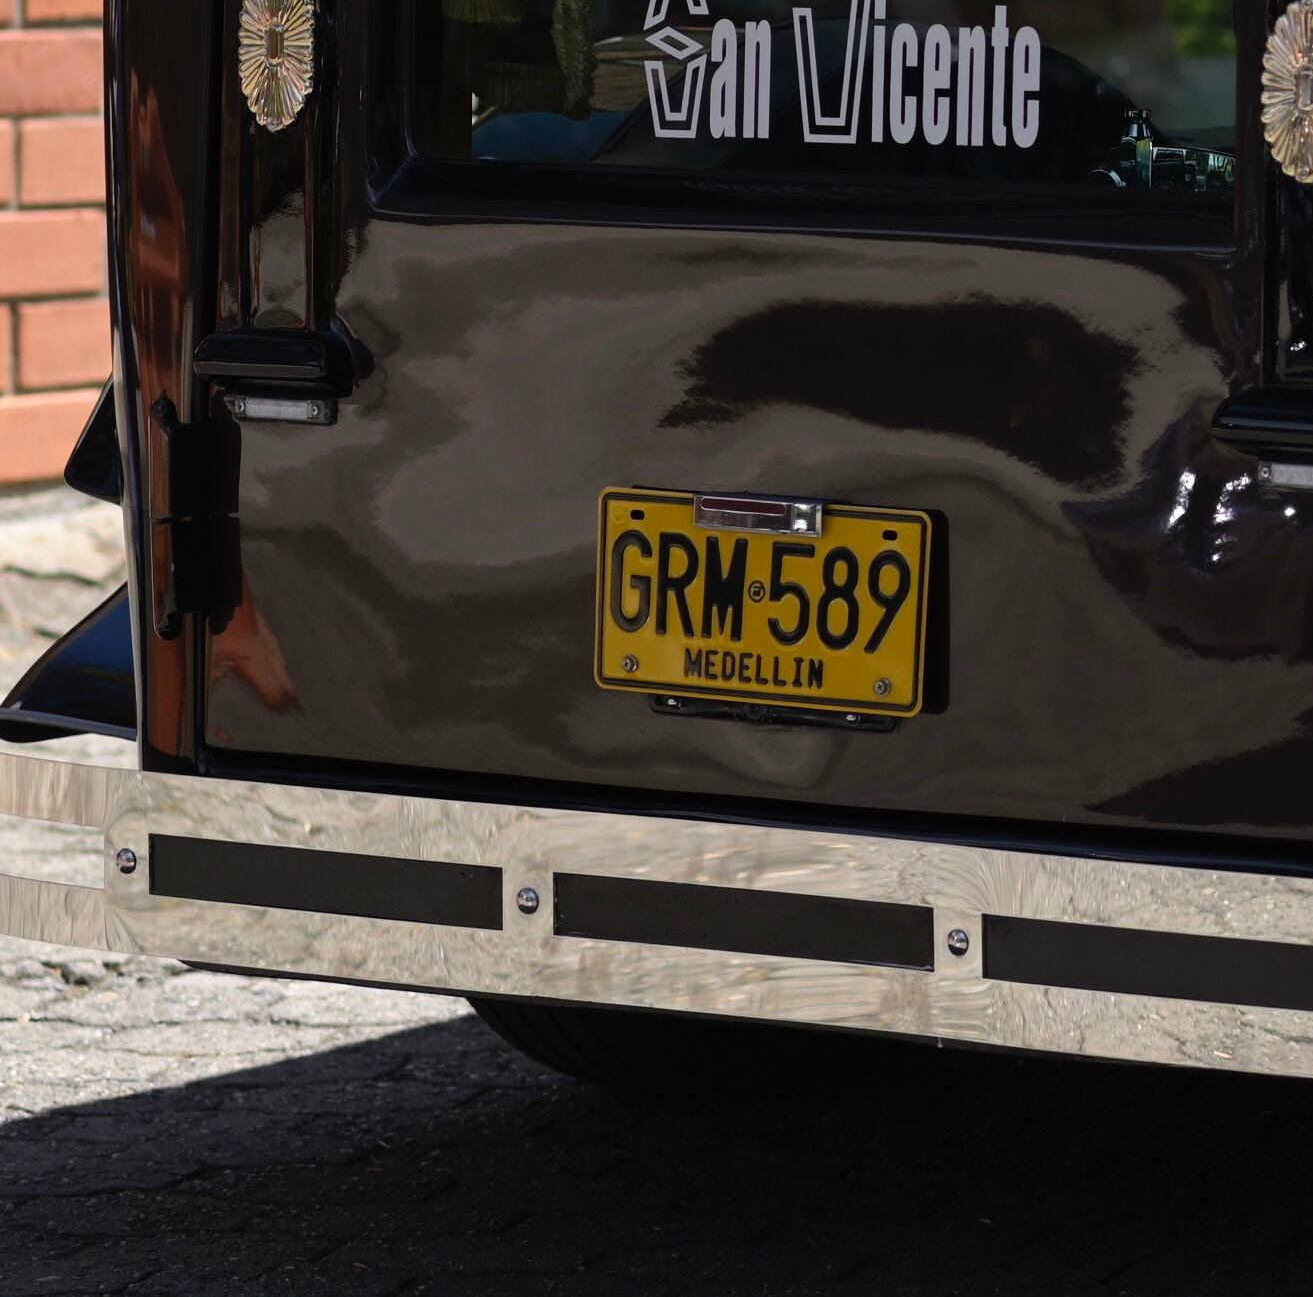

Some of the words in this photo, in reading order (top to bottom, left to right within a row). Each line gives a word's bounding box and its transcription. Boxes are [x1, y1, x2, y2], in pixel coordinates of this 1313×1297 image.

[611, 530, 748, 642] GRM
[767, 541, 911, 654] 589
[683, 647, 824, 690] MEDELLIN
